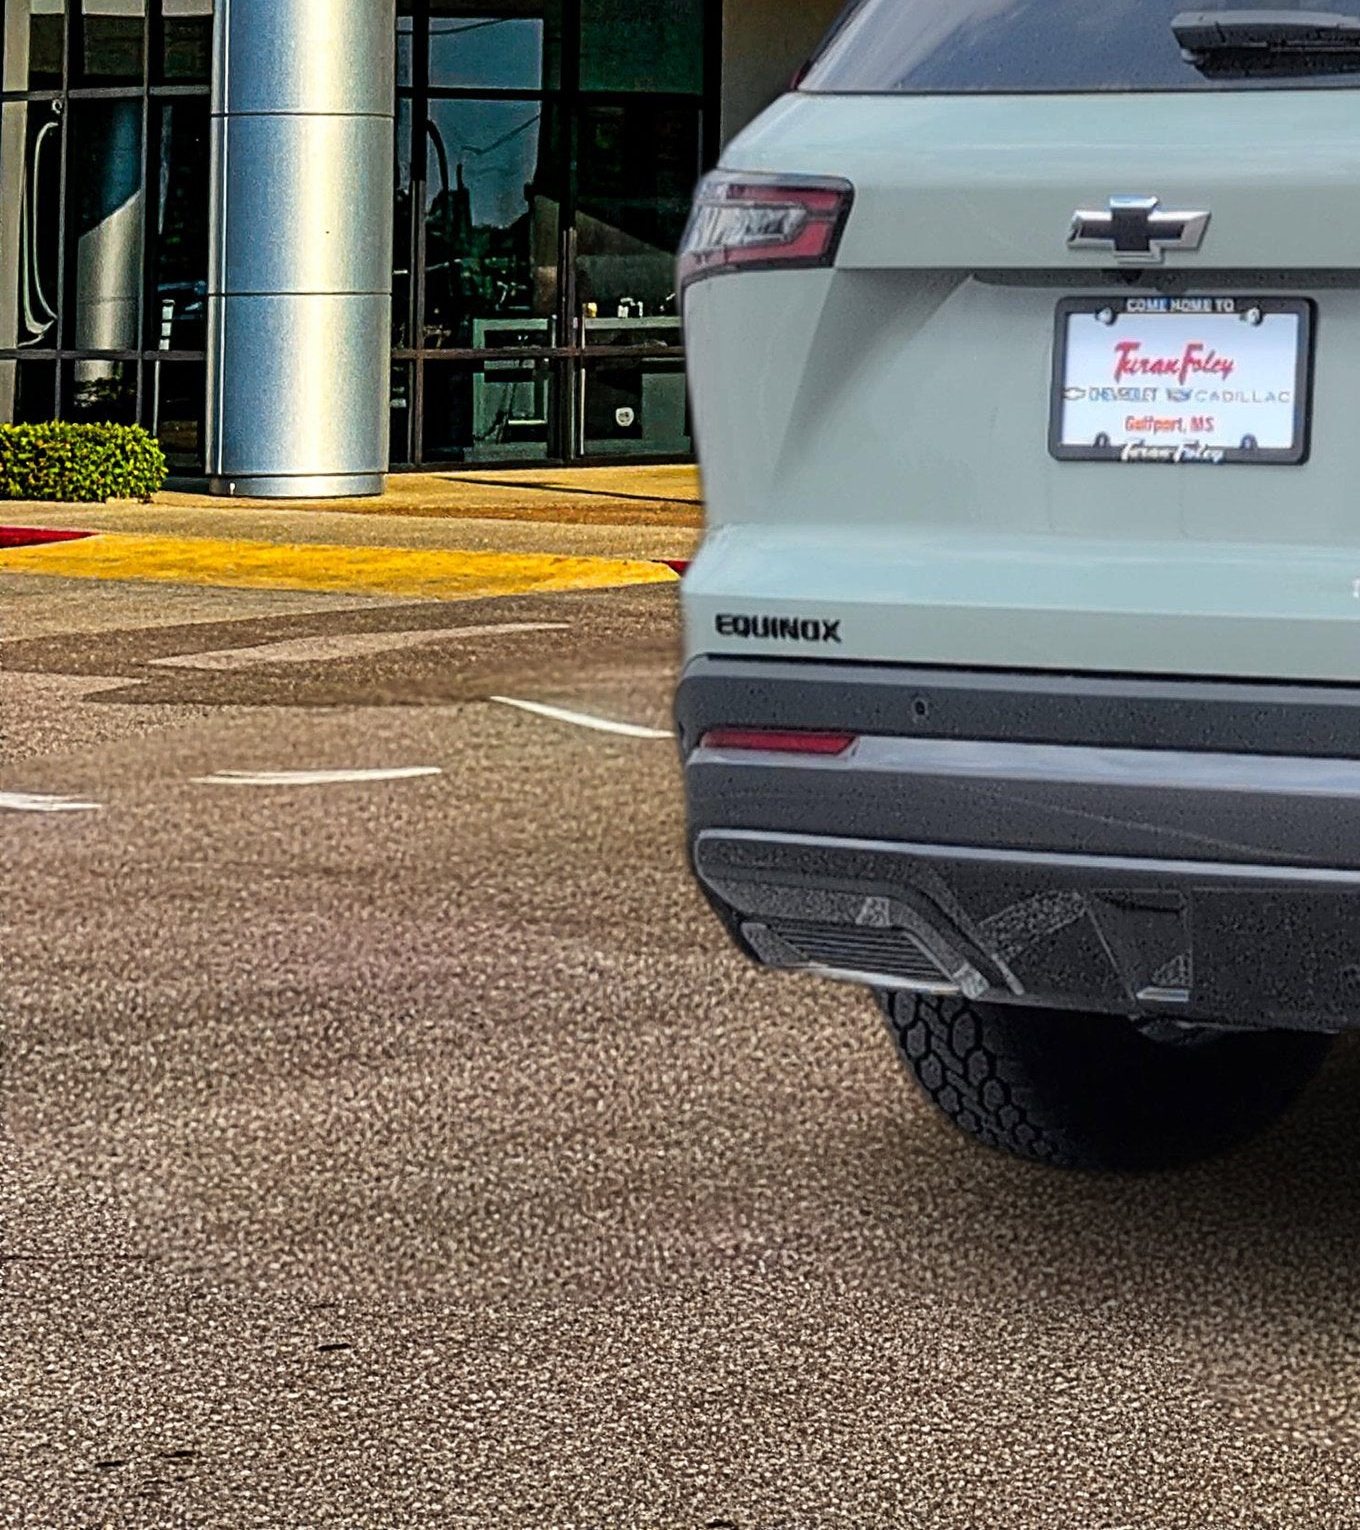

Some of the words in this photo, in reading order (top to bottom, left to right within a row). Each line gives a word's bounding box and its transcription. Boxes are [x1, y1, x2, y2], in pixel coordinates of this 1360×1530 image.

[1126, 298, 1168, 312] COME
[1170, 298, 1211, 312] HOME
[1215, 298, 1235, 312] TO
[1194, 389, 1291, 403] CADILLAC
[1124, 415, 1187, 435] Gulfport,
[1190, 416, 1215, 432] MS
[714, 613, 842, 644] EQUINOX
